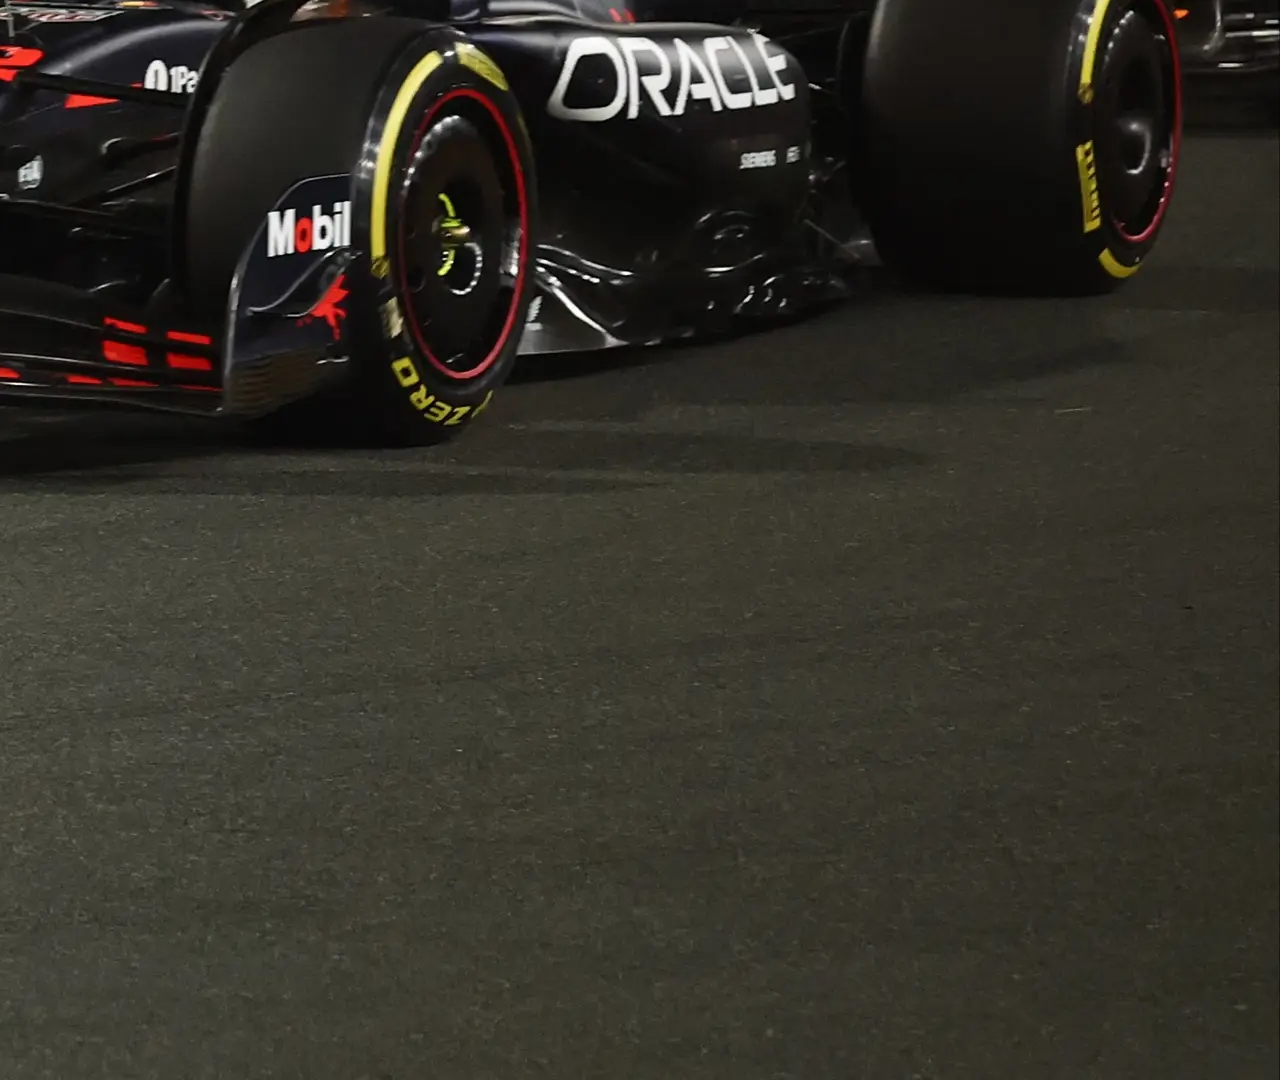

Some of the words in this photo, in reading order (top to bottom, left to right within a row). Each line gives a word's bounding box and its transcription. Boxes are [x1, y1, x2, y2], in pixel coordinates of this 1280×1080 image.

[546, 31, 796, 122] ORACLE
[267, 200, 352, 258] Mobil
[391, 356, 473, 426] ZERO
